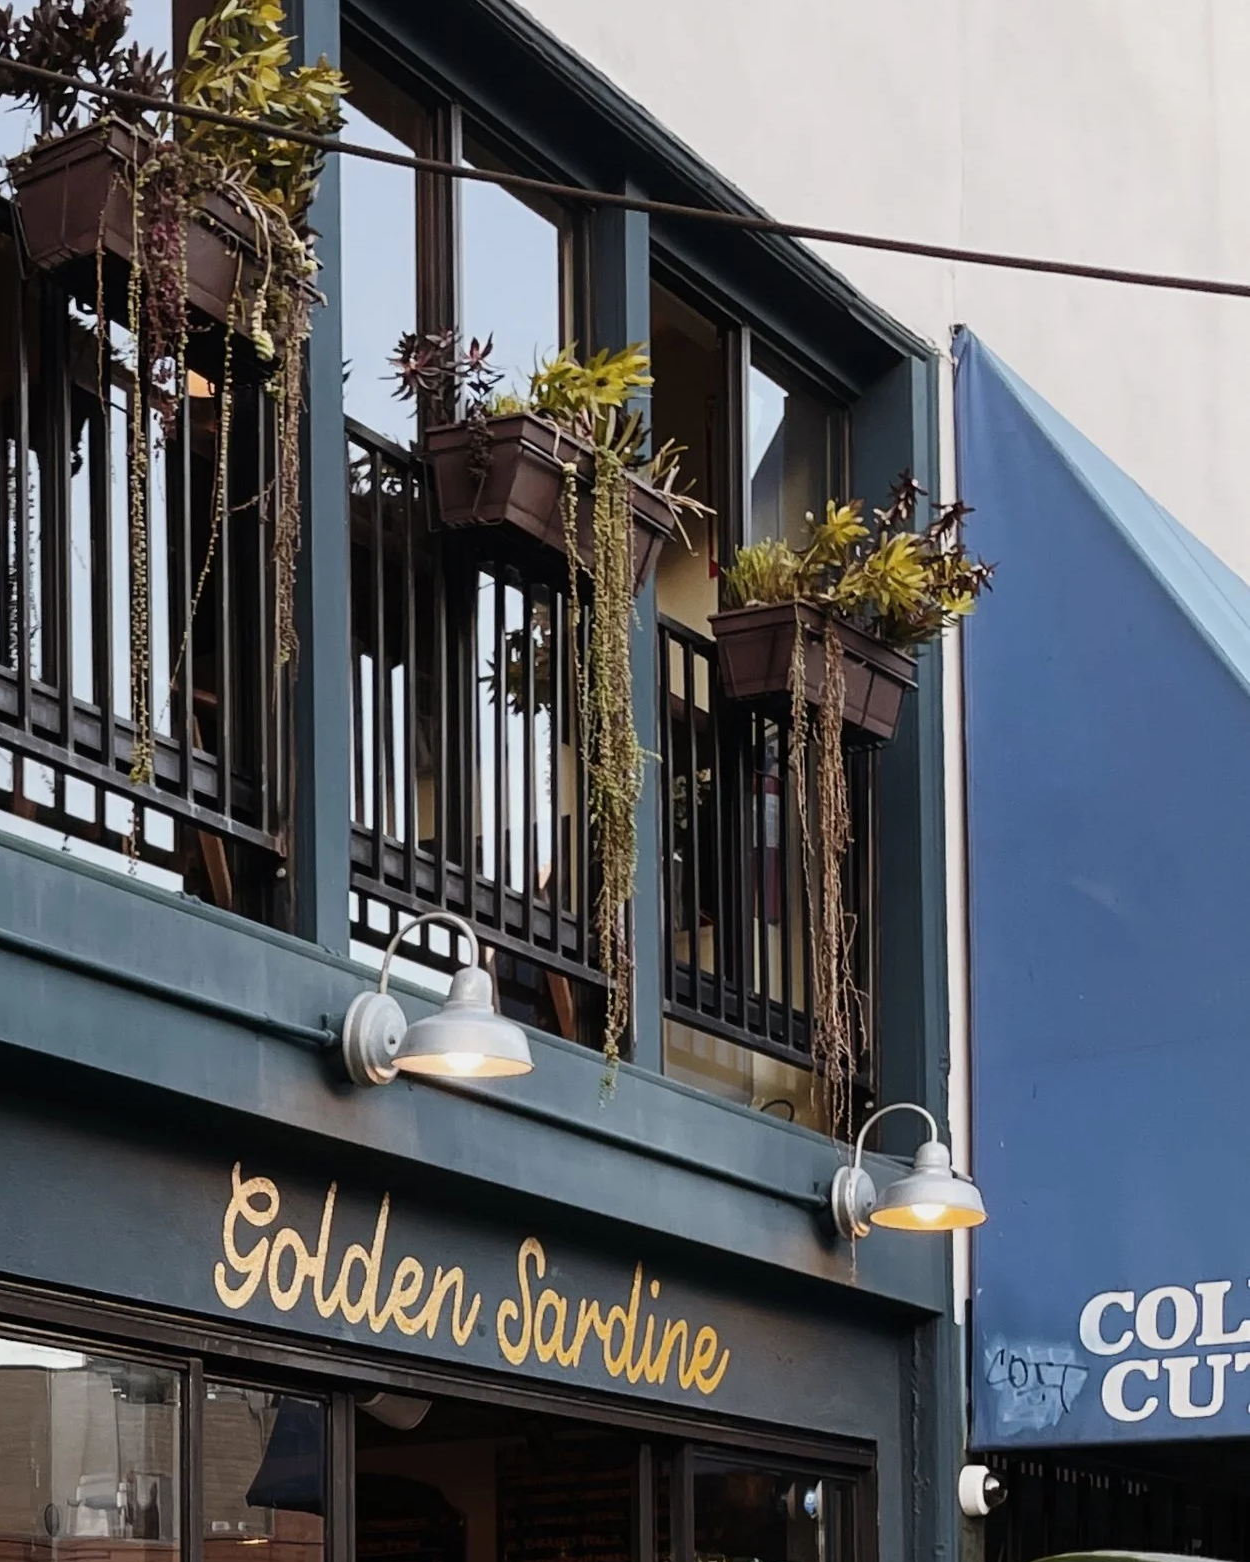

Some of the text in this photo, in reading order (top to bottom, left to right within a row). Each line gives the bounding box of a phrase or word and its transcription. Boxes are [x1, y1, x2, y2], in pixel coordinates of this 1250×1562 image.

[213, 1158, 730, 1395] Golden Sardine
[1079, 1279, 1250, 1356] COL
